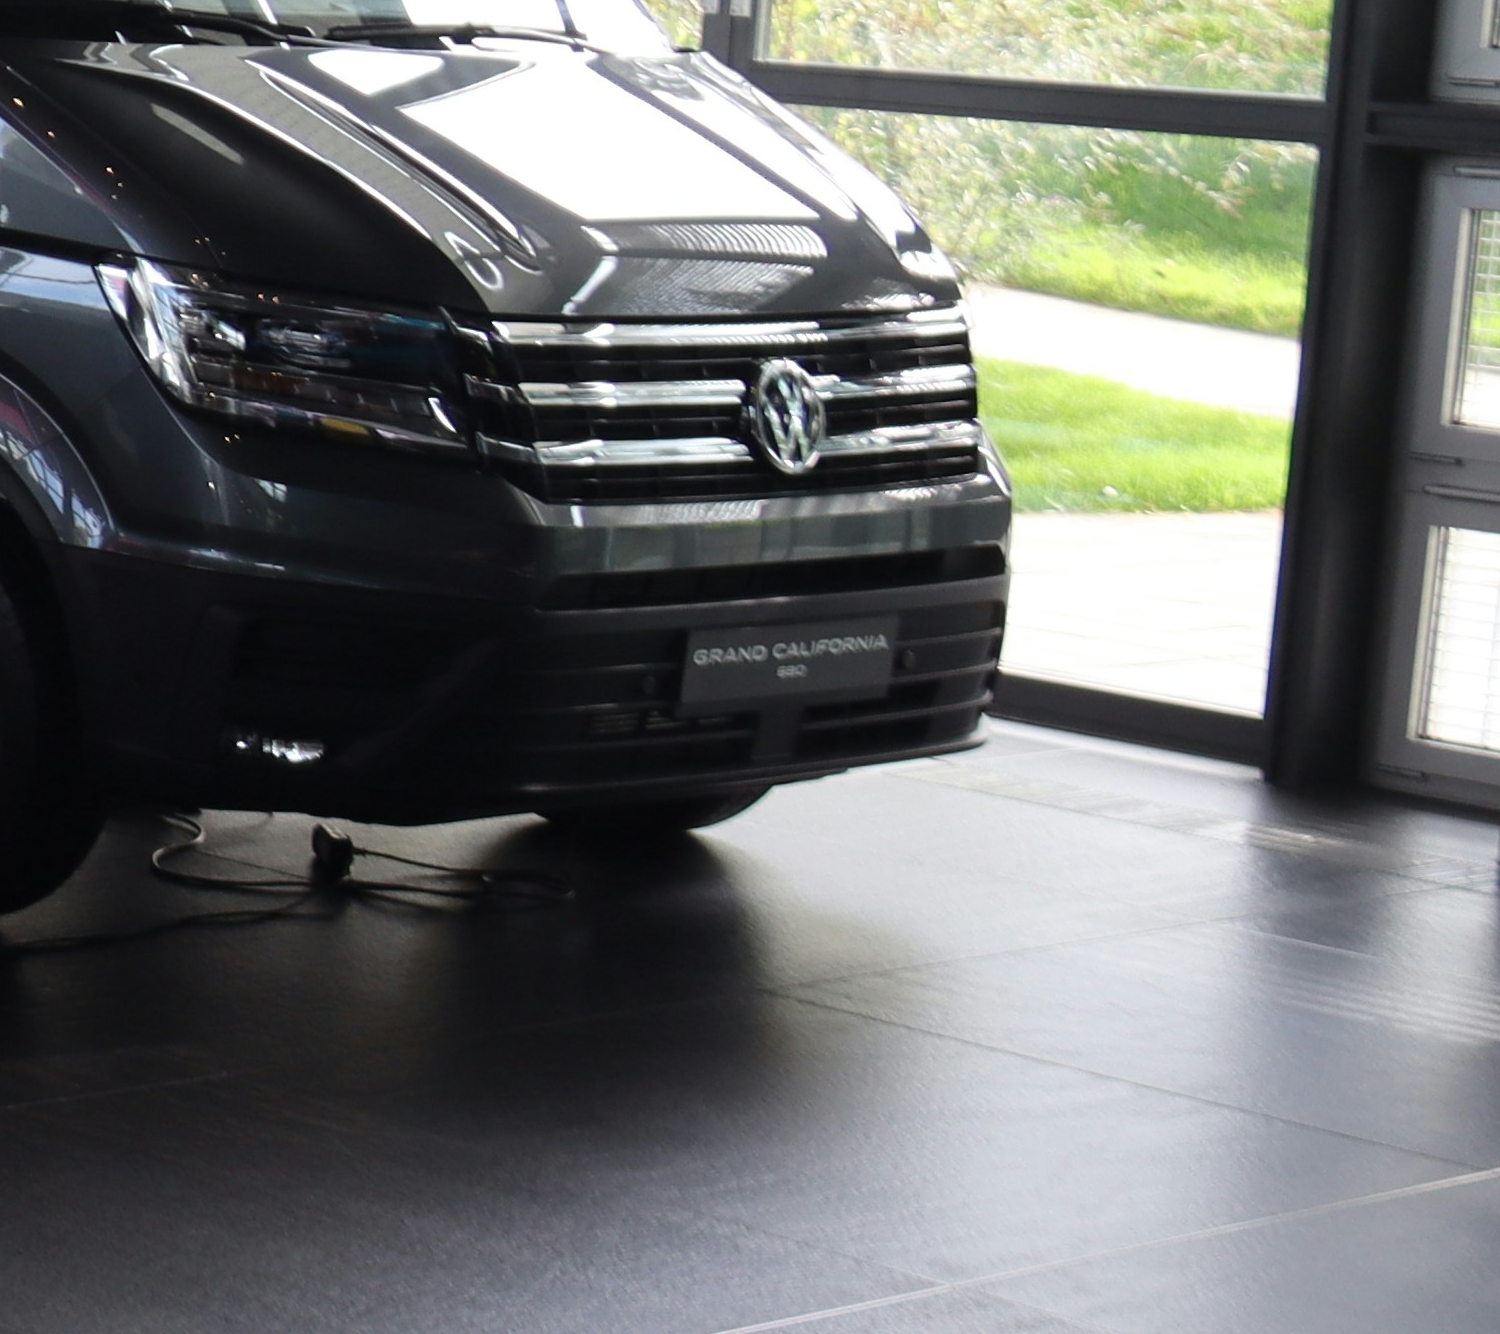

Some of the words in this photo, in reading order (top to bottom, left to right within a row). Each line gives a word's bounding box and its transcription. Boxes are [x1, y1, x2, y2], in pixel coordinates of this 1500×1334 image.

[759, 359, 825, 473] VW
[693, 644, 768, 666] GRAND
[772, 633, 889, 660] CALIFORNIA
